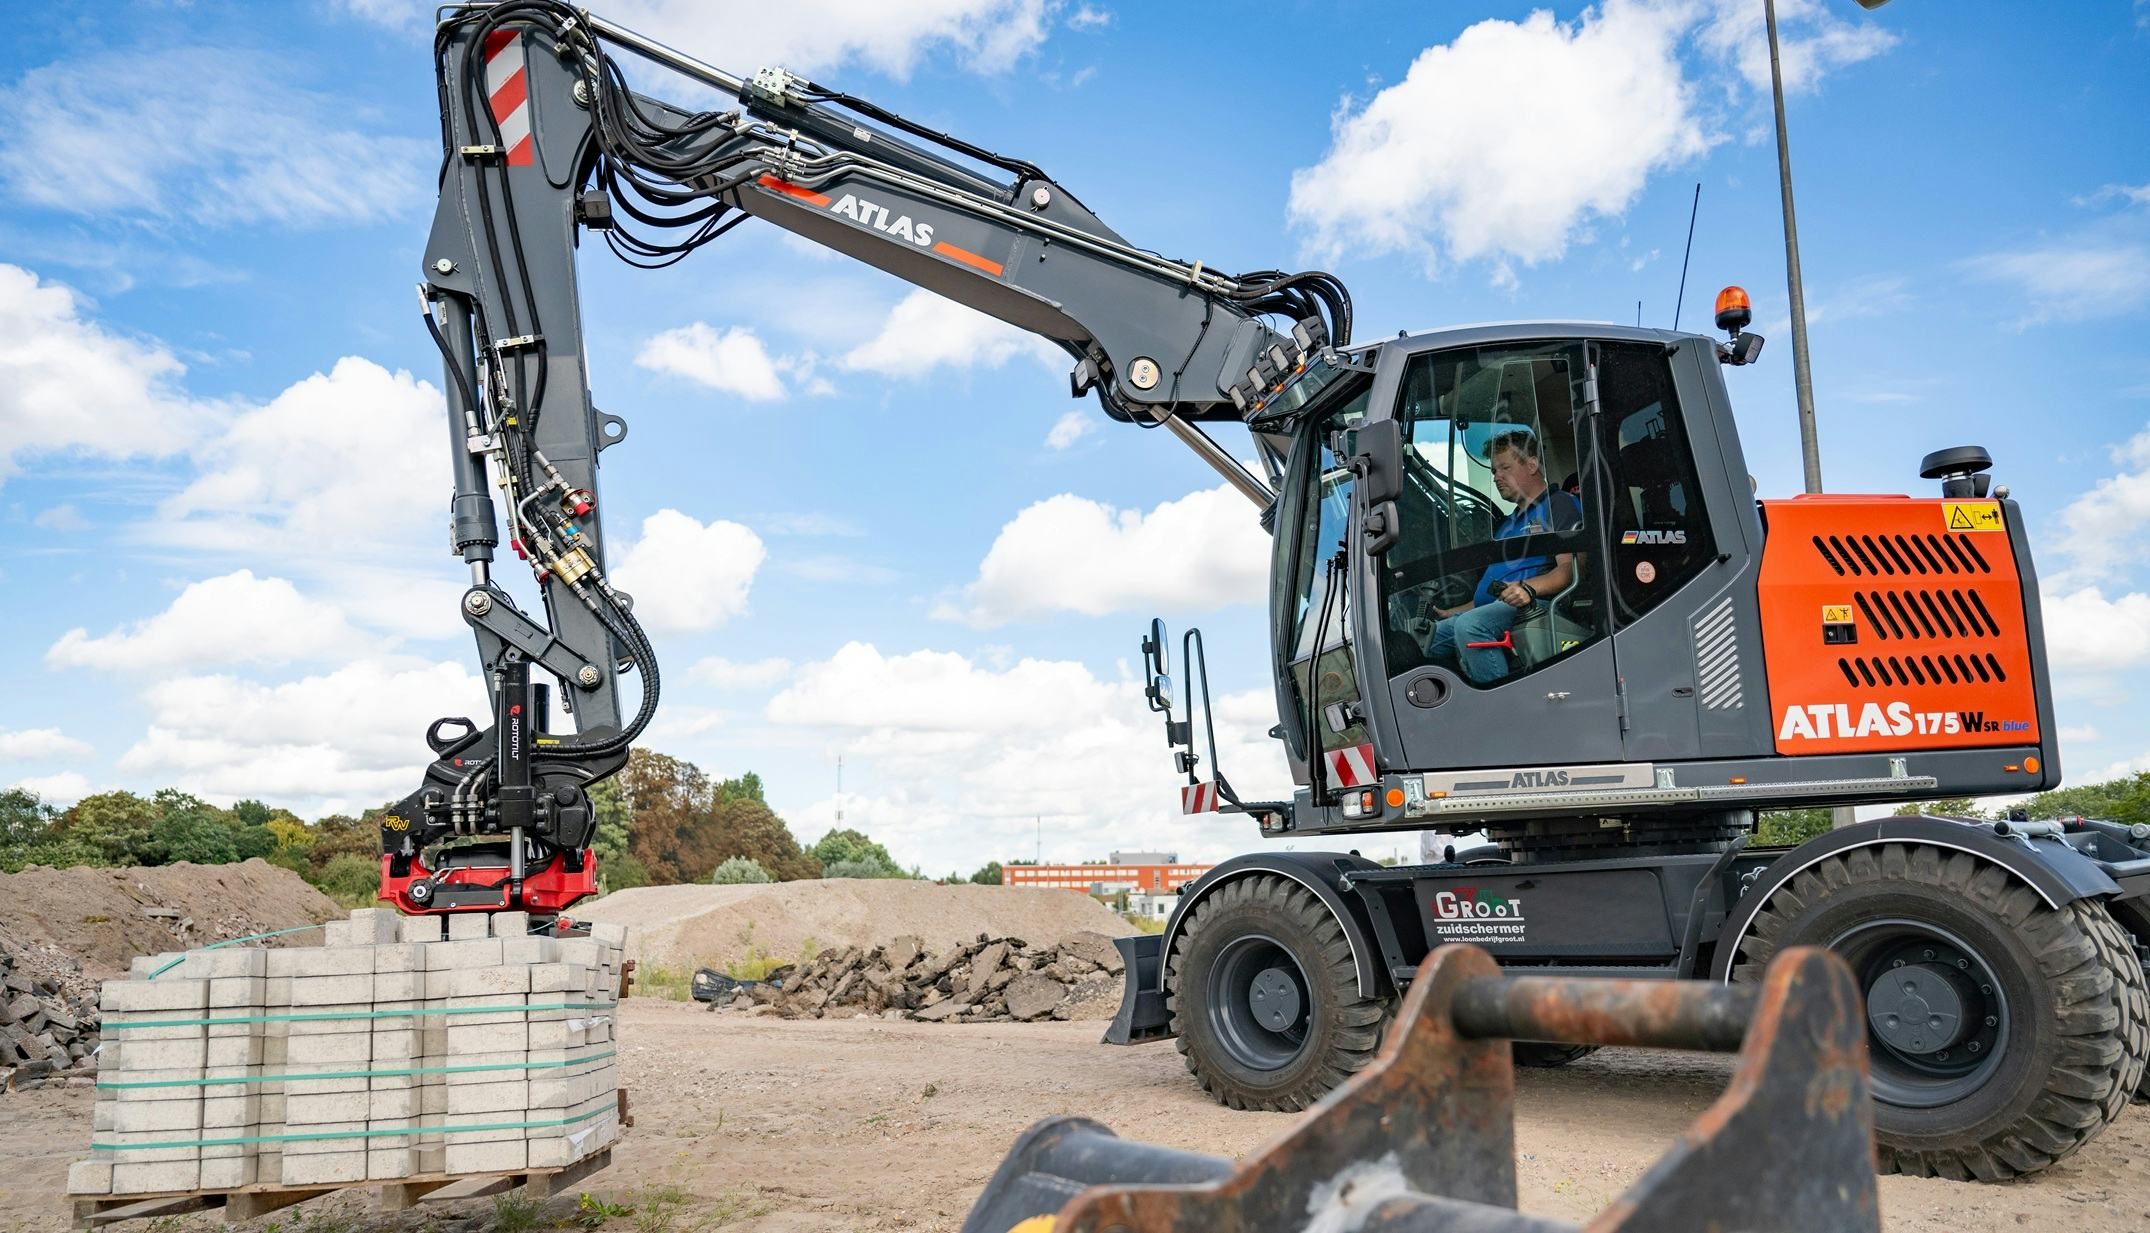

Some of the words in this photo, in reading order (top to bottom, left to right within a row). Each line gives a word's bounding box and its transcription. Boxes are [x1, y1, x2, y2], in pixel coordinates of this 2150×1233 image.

[830, 194, 934, 246] ATLAS
[1637, 530, 1686, 544] ATLAS
[1779, 701, 1913, 740] ATLAS
[2002, 720, 2030, 731] blue
[511, 718, 519, 761] ROTOTILT
[1511, 771, 1569, 788] ATLAS
[1436, 924, 1526, 934] zuidschermer
[1443, 936, 1526, 944] www.loonbedrijfgroot.nl
